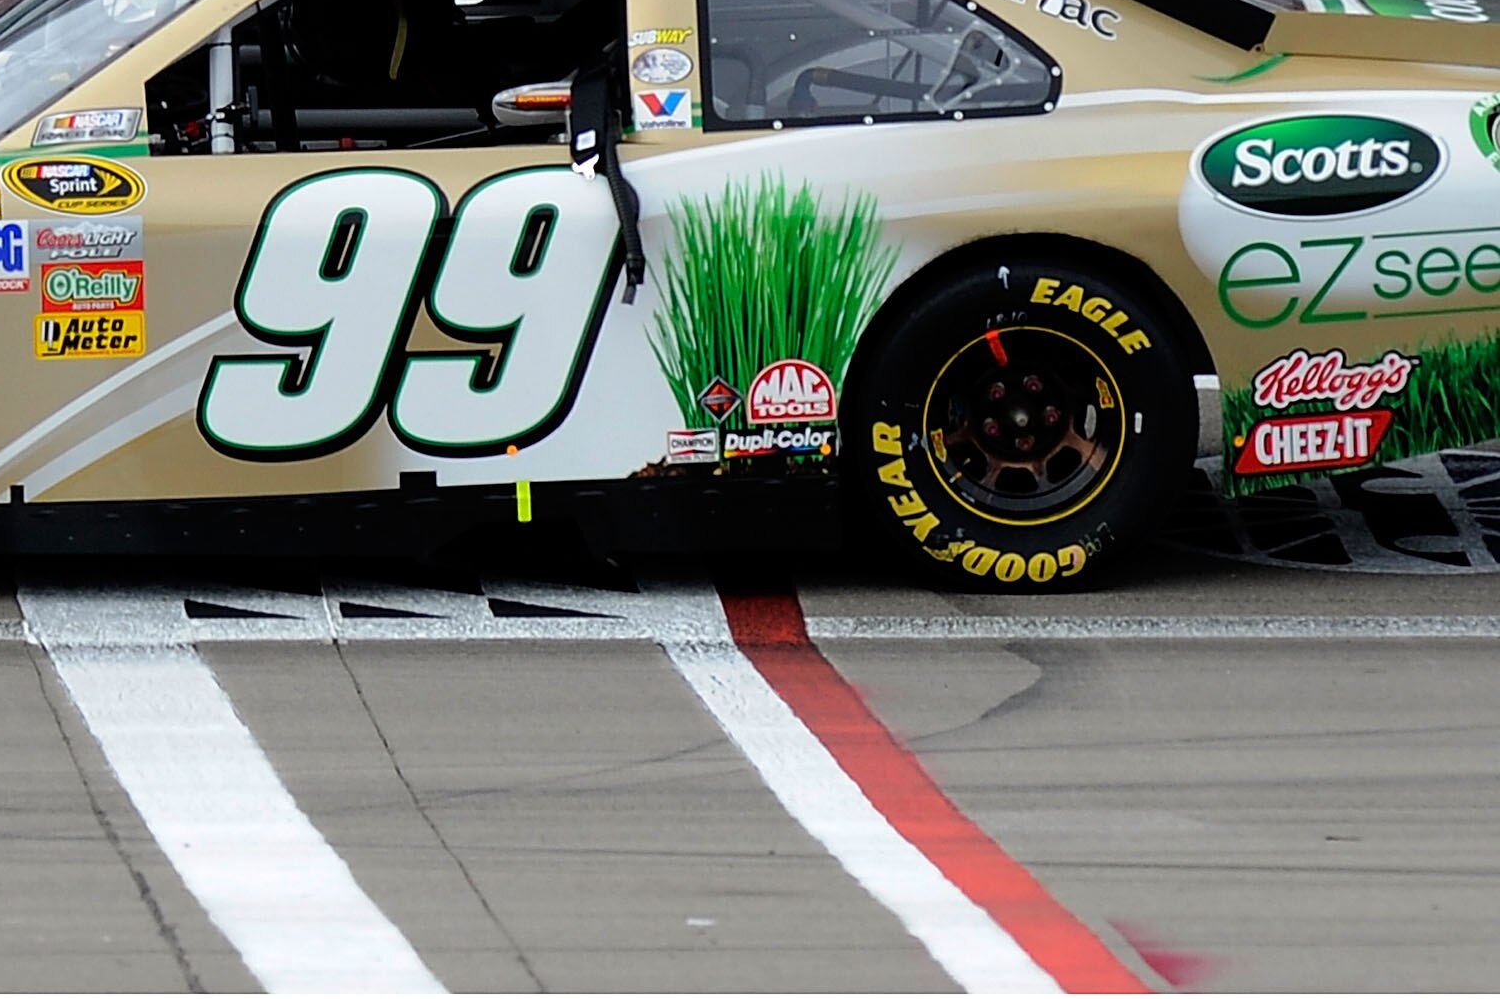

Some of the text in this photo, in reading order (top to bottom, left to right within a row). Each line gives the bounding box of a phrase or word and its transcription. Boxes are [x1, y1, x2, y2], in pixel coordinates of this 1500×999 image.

[628, 27, 693, 48] SUBWAY
[639, 119, 686, 130] Valvoline
[42, 165, 90, 179] NASCAR
[1232, 138, 1411, 188] Scotts
[49, 178, 98, 196] Sprint
[58, 200, 128, 209] CUP SERIES
[37, 228, 137, 249] Coors LIGHT
[49, 247, 123, 260] POLE
[49, 271, 136, 301] O'Reilly
[198, 167, 626, 460] 99
[1030, 277, 1152, 355] EAGLE
[66, 317, 124, 334] Auto
[62, 334, 138, 351] Meter
[753, 365, 830, 404] MAC
[1255, 351, 1410, 408] Kellogg's
[753, 402, 830, 418] TOOLS
[671, 437, 715, 450] CHAMPION
[725, 426, 832, 453] Dupli-Color
[872, 421, 1087, 583] GOODYEAR
